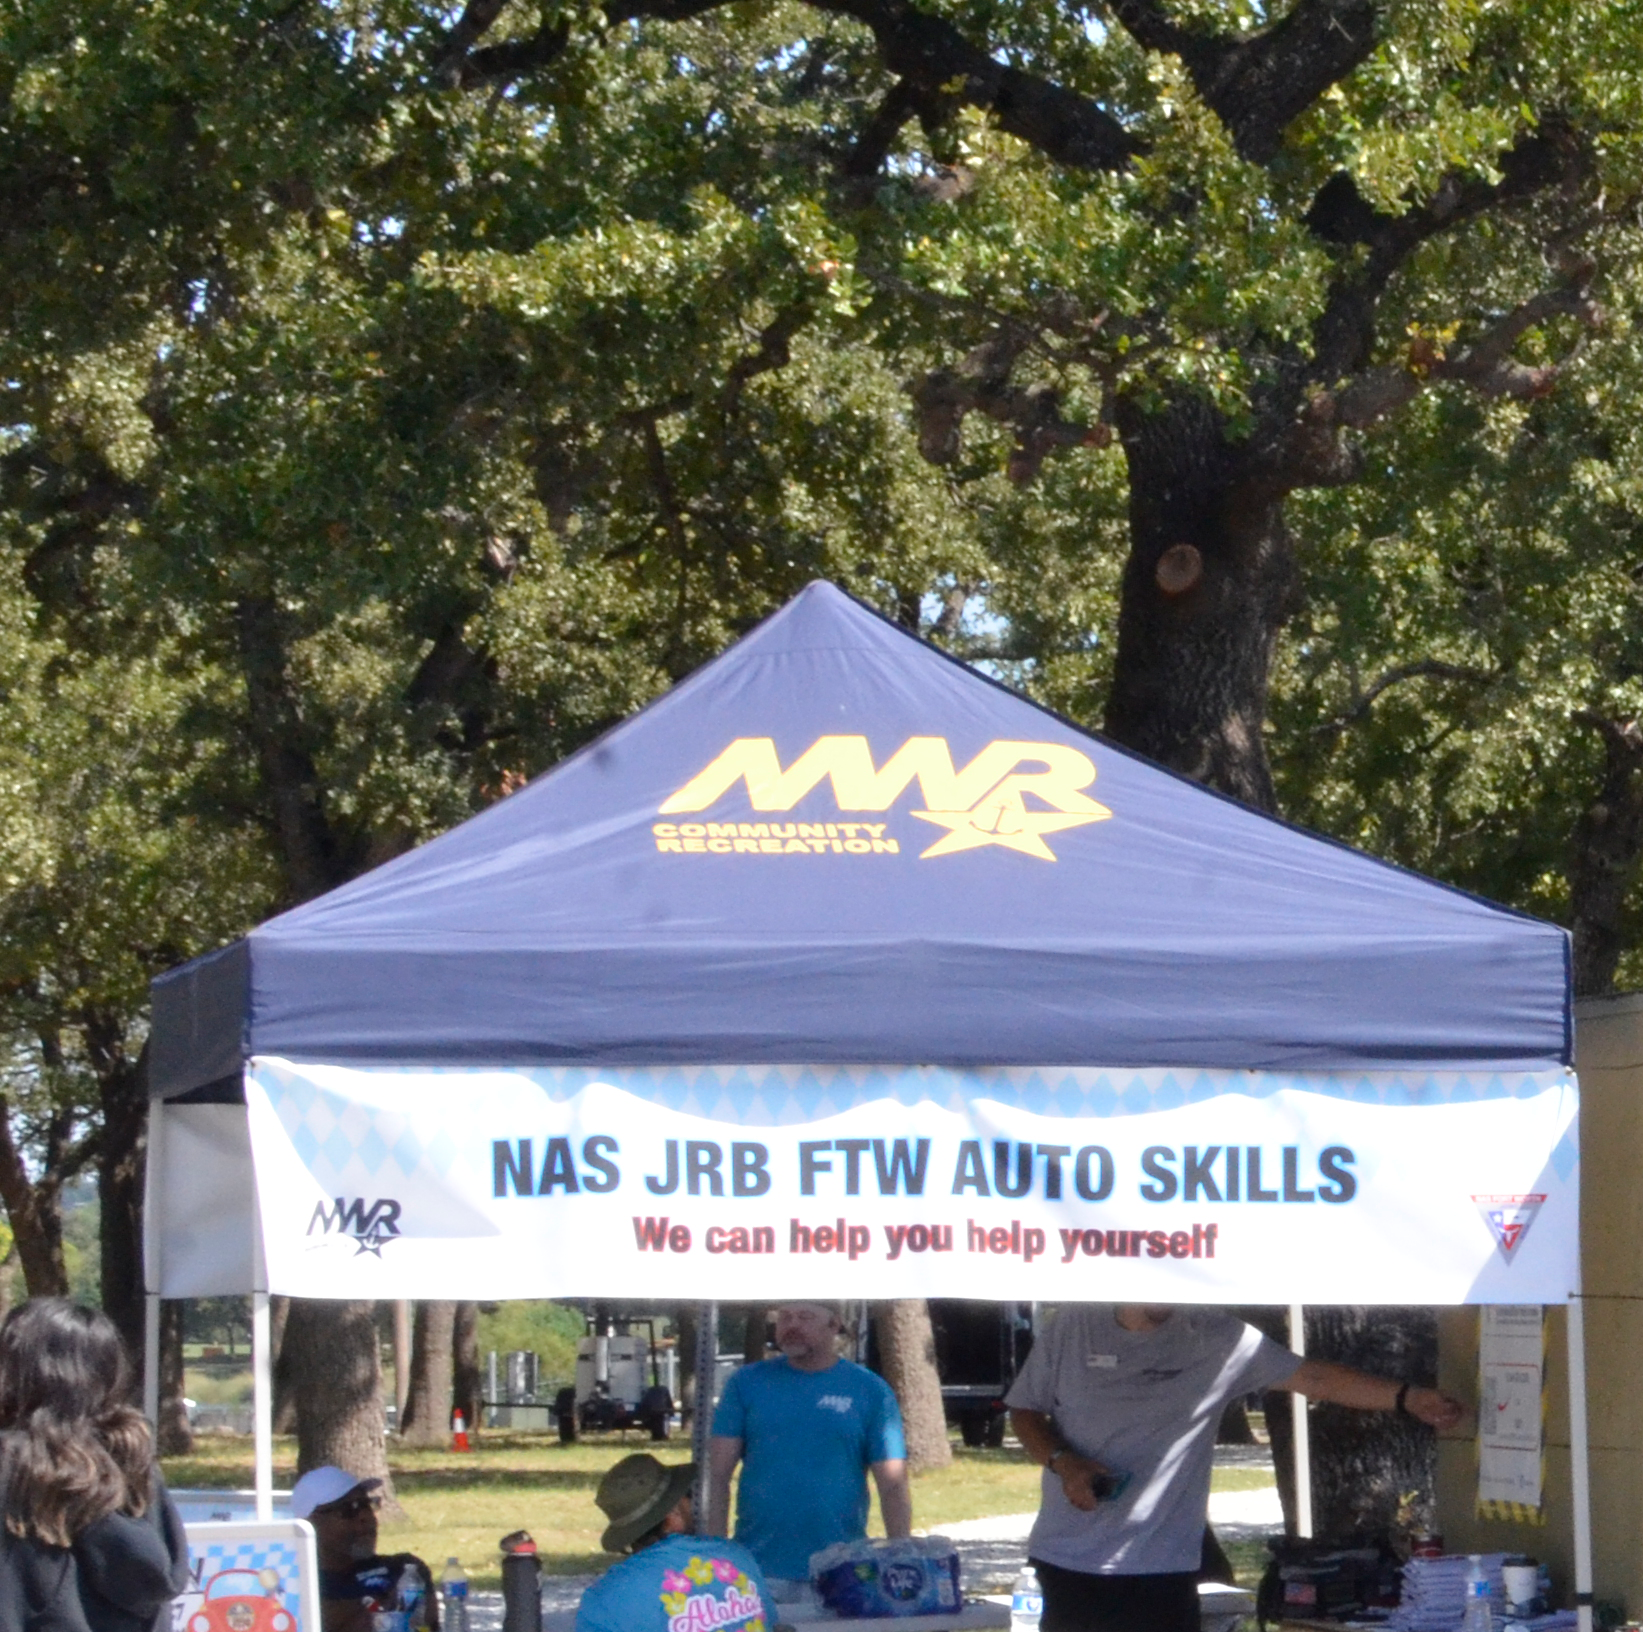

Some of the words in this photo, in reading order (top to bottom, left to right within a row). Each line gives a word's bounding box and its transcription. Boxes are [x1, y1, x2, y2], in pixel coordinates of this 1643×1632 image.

[657, 735, 1112, 815] MWR
[652, 822, 888, 839] COMMUNITY
[655, 838, 900, 855] RECREATION
[491, 1134, 621, 1198] NAS
[644, 1138, 772, 1198] JRB
[799, 1137, 931, 1197] FTW
[951, 1138, 1116, 1202] AUTO
[1139, 1144, 1358, 1203] SKILLS
[632, 1216, 691, 1253] We
[705, 1225, 776, 1254] can
[789, 1217, 871, 1260] help
[884, 1223, 954, 1260] you
[967, 1218, 1046, 1263] help
[1058, 1223, 1219, 1263] yourself
